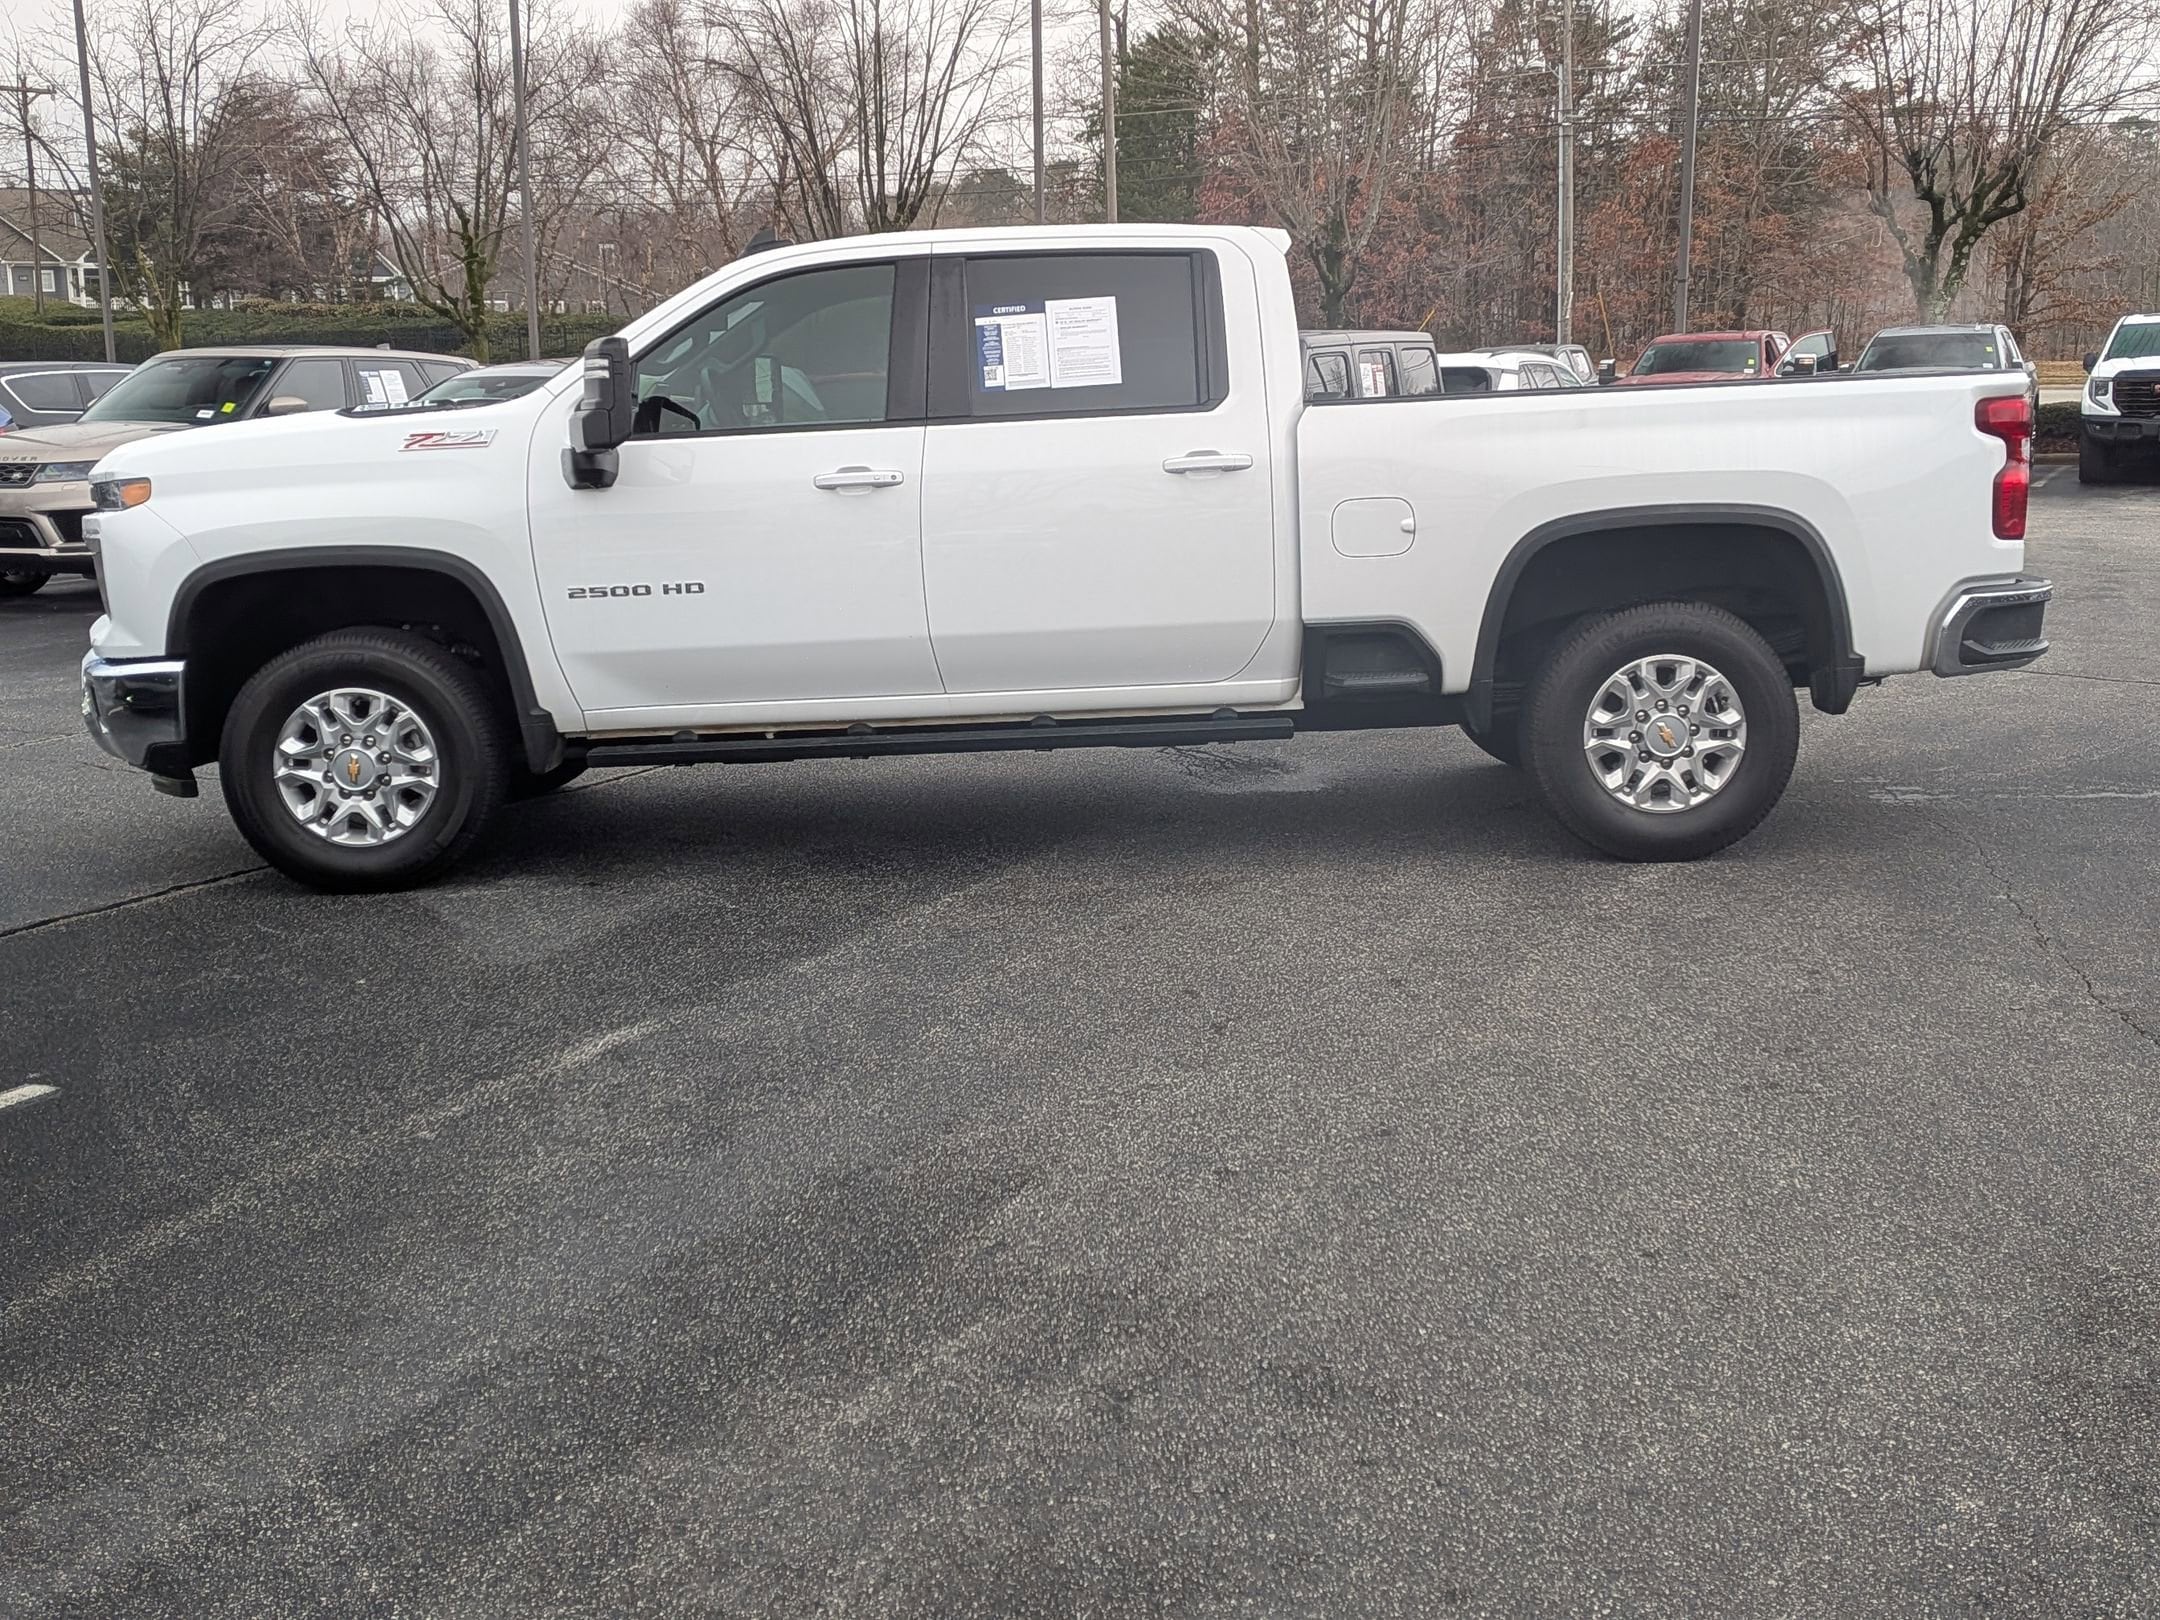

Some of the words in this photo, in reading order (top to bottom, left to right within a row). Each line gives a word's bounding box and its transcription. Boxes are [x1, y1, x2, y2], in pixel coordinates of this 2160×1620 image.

[993, 305, 1026, 314] CERTIFIED
[398, 429, 497, 452] Z71
[567, 584, 652, 599] 2500
[662, 582, 705, 595] HD
